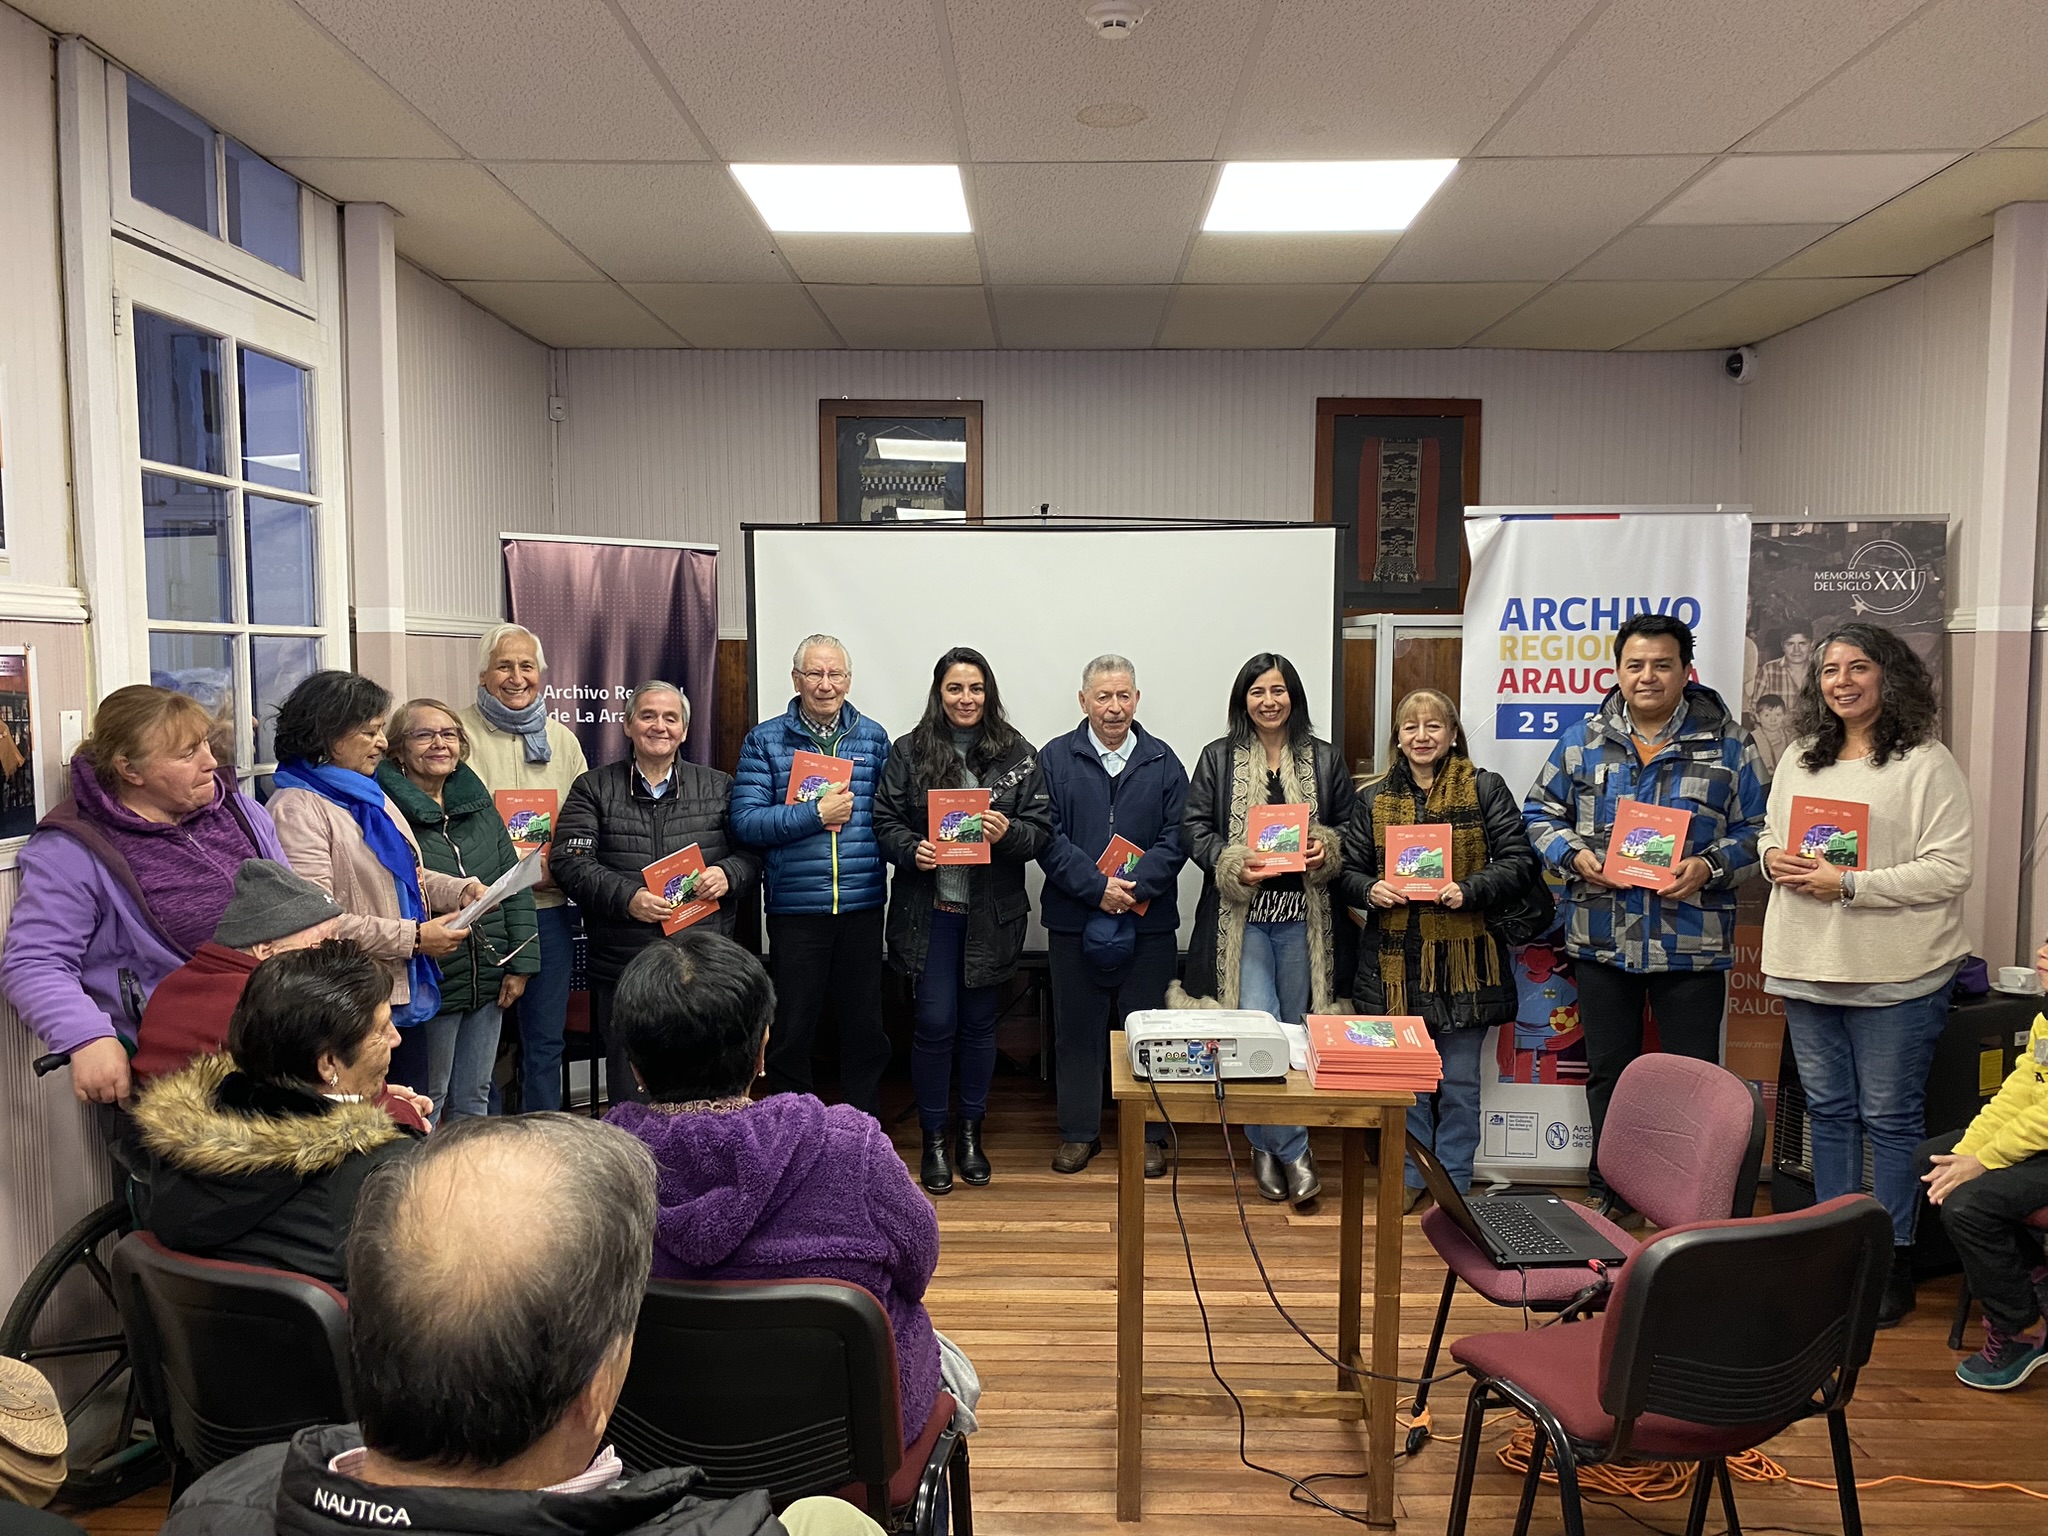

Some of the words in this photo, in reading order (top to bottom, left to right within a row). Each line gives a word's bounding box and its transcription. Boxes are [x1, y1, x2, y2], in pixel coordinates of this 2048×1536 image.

[1813, 581, 1834, 591] DEL
[1837, 581, 1872, 591] SIGLO
[1874, 570, 1916, 591] XXI
[1814, 570, 1871, 580] MEMORIAS
[1499, 597, 1702, 632] ARCHIVO
[1500, 634, 1617, 661] REGIO
[543, 684, 609, 700] Archivo
[550, 708, 570, 723] de
[576, 708, 594, 723] La
[1572, 1125, 1593, 1133] Arch
[314, 1487, 412, 1527] NAUTICA
